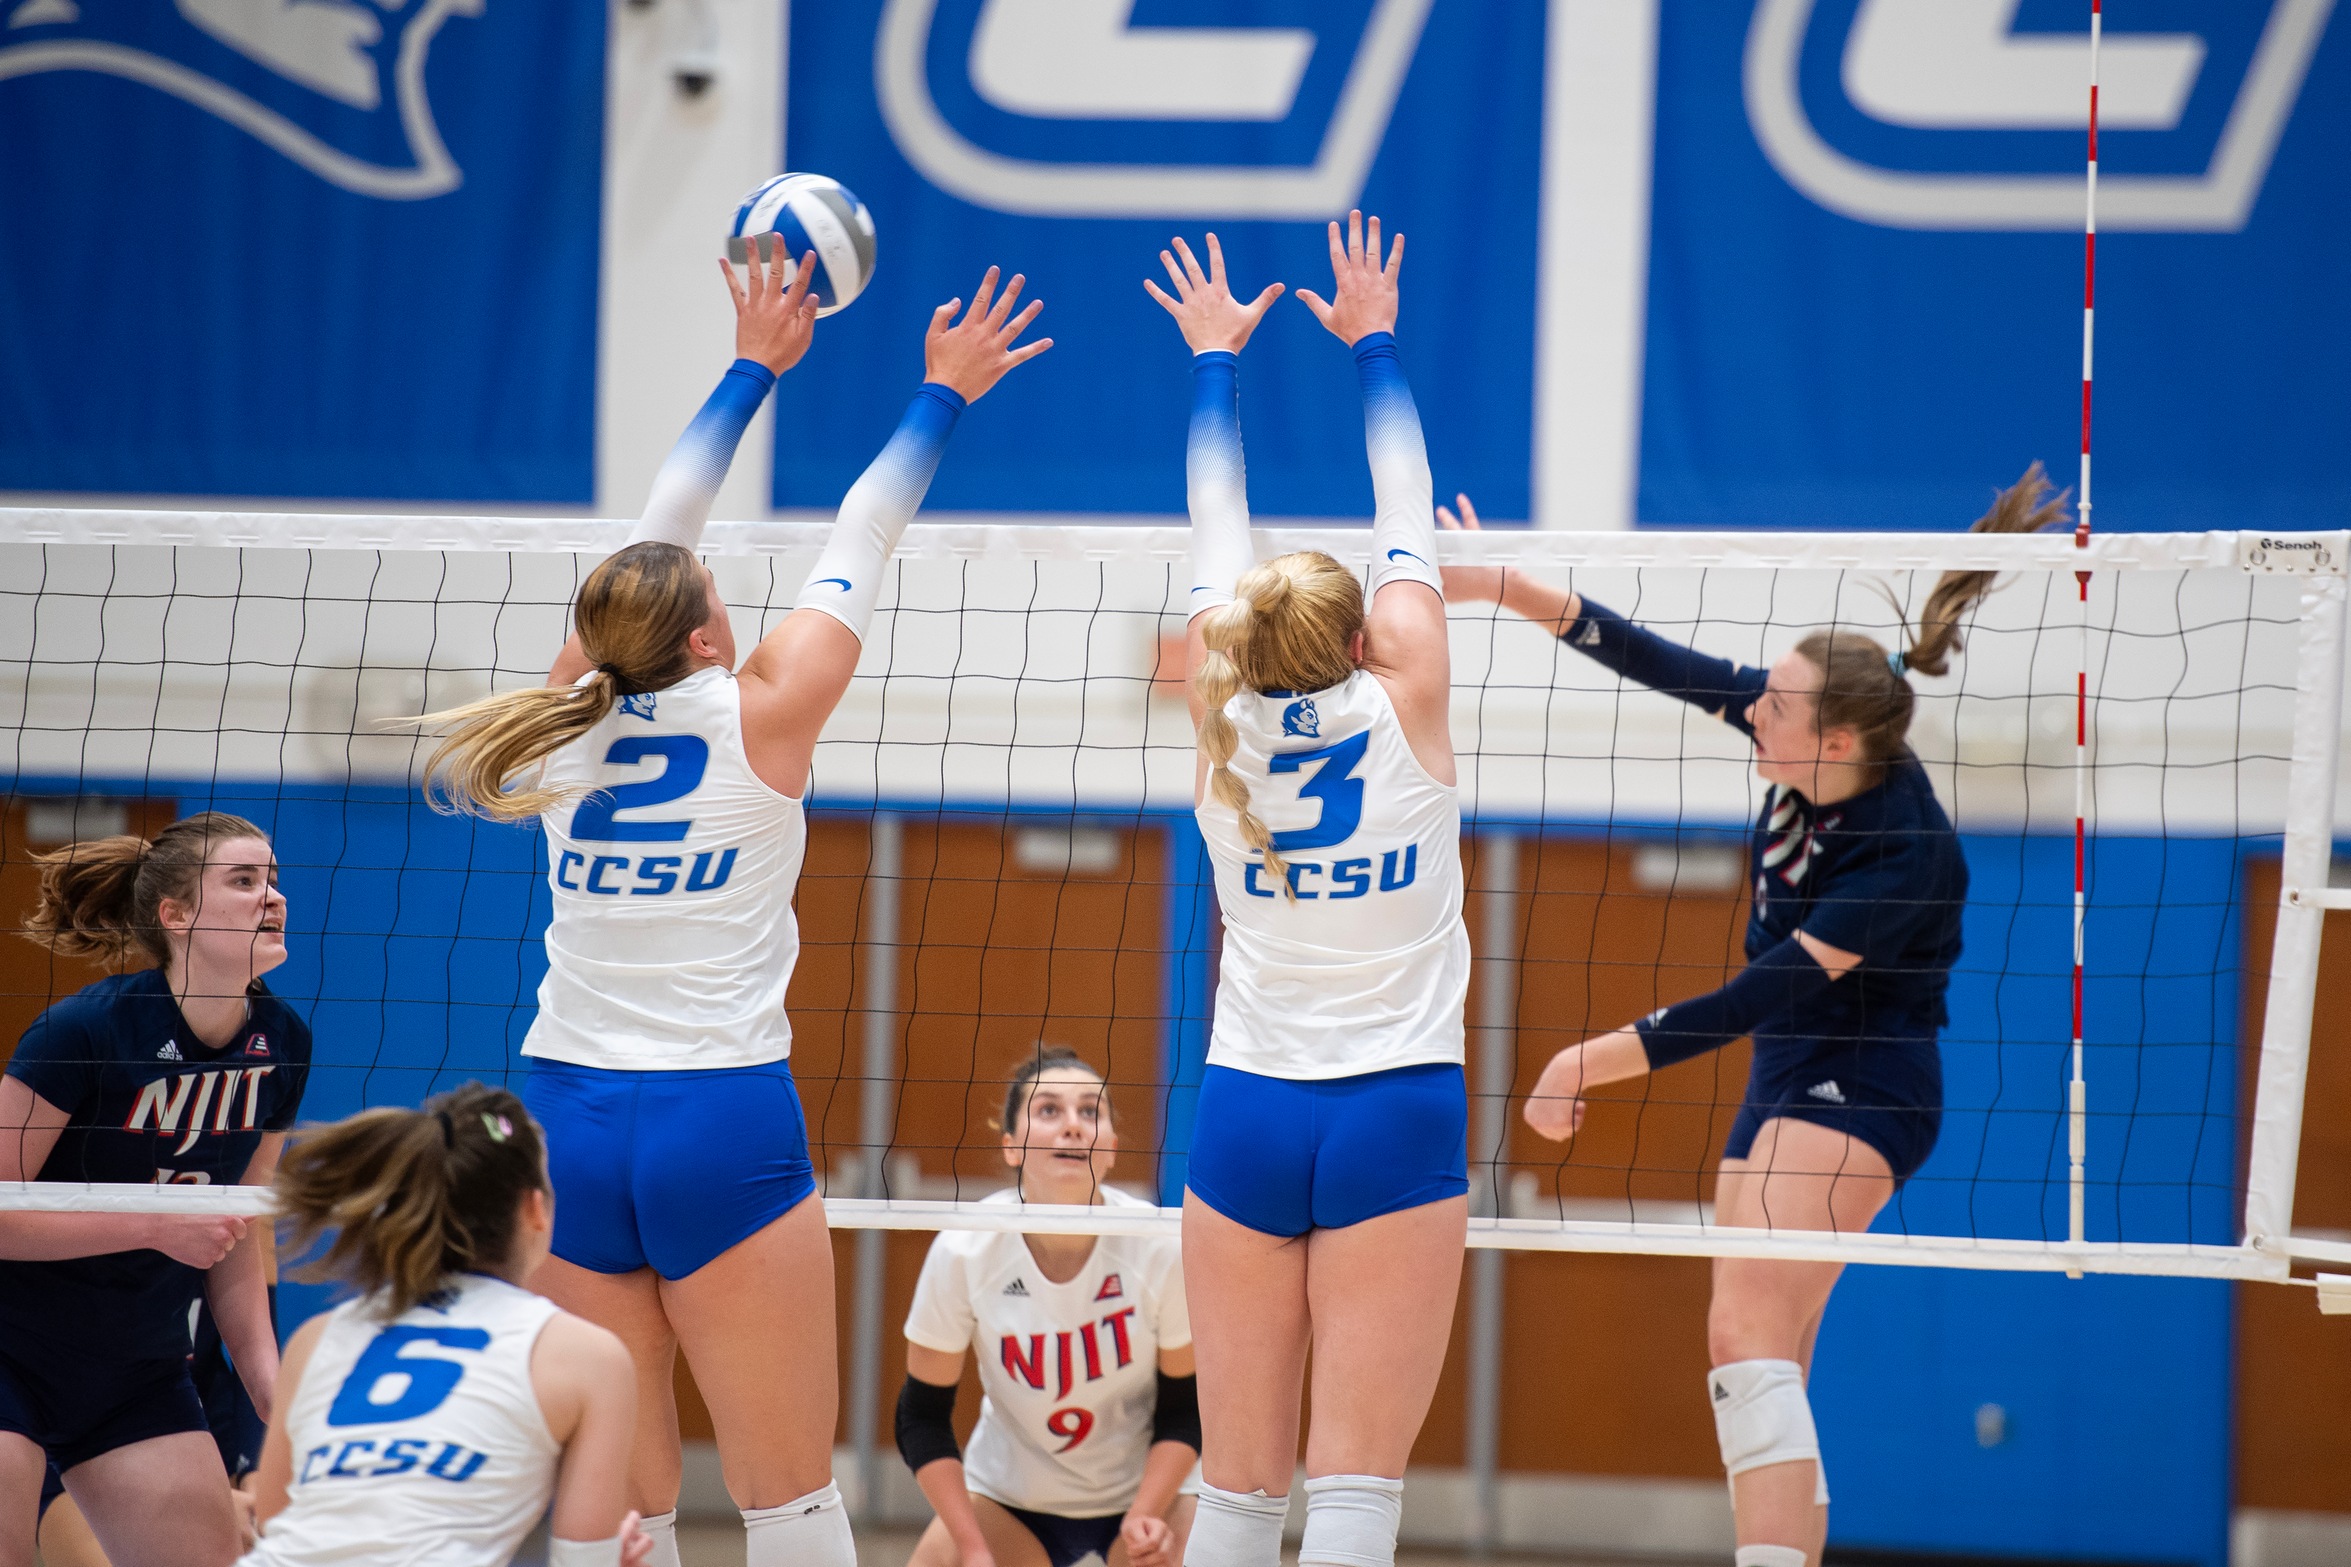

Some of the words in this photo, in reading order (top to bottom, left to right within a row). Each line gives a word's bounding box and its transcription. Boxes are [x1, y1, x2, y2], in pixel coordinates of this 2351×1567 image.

[2273, 540, 2322, 550] Senoh
[570, 733, 711, 843] 2
[1250, 728, 1373, 854] 3
[557, 846, 740, 895] CCSU
[1243, 842, 1419, 899] CCSU
[123, 1065, 276, 1156] NJIT
[326, 1324, 492, 1428] 6
[1001, 1306, 1135, 1402] NJIT
[300, 1438, 488, 1485] CCSU
[1047, 1407, 1094, 1454] 9
